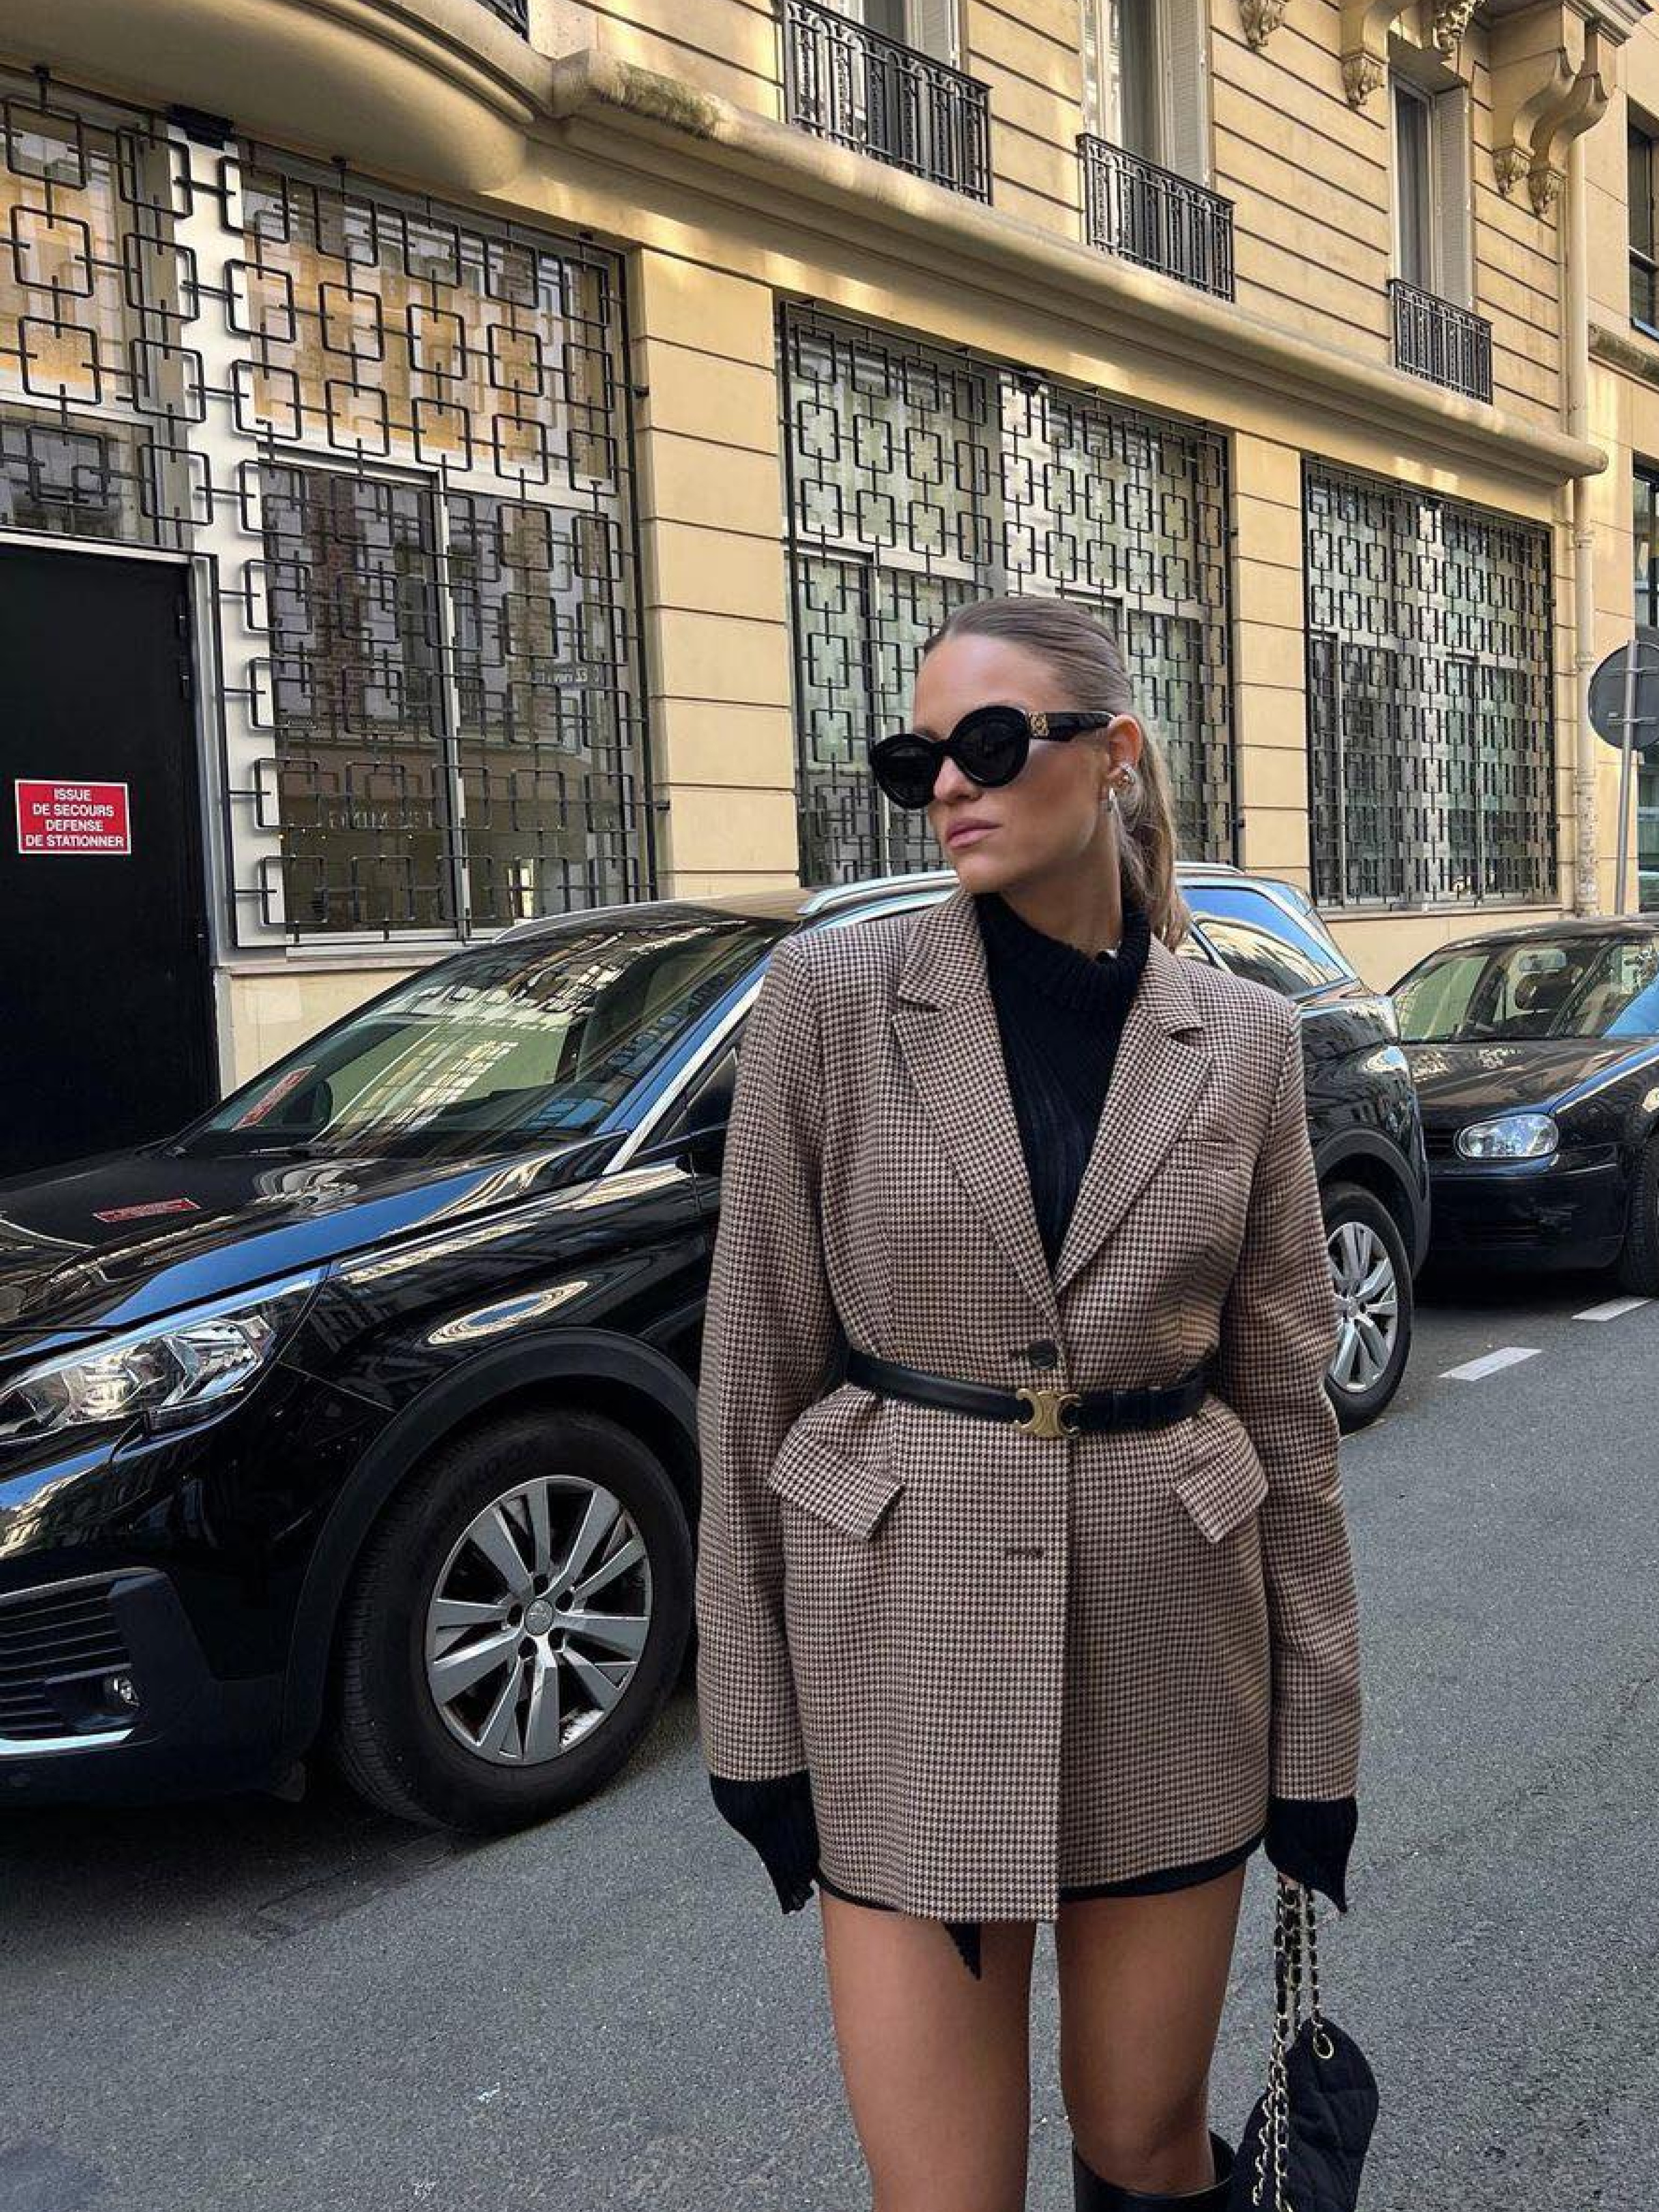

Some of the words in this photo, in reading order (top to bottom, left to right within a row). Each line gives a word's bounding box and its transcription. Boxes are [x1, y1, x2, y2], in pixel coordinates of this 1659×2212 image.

[54, 788, 92, 801] ISSUE
[33, 802, 51, 817] DE
[54, 803, 114, 817] SECOURS
[26, 834, 43, 846] DE
[46, 834, 124, 847] STATIONNER
